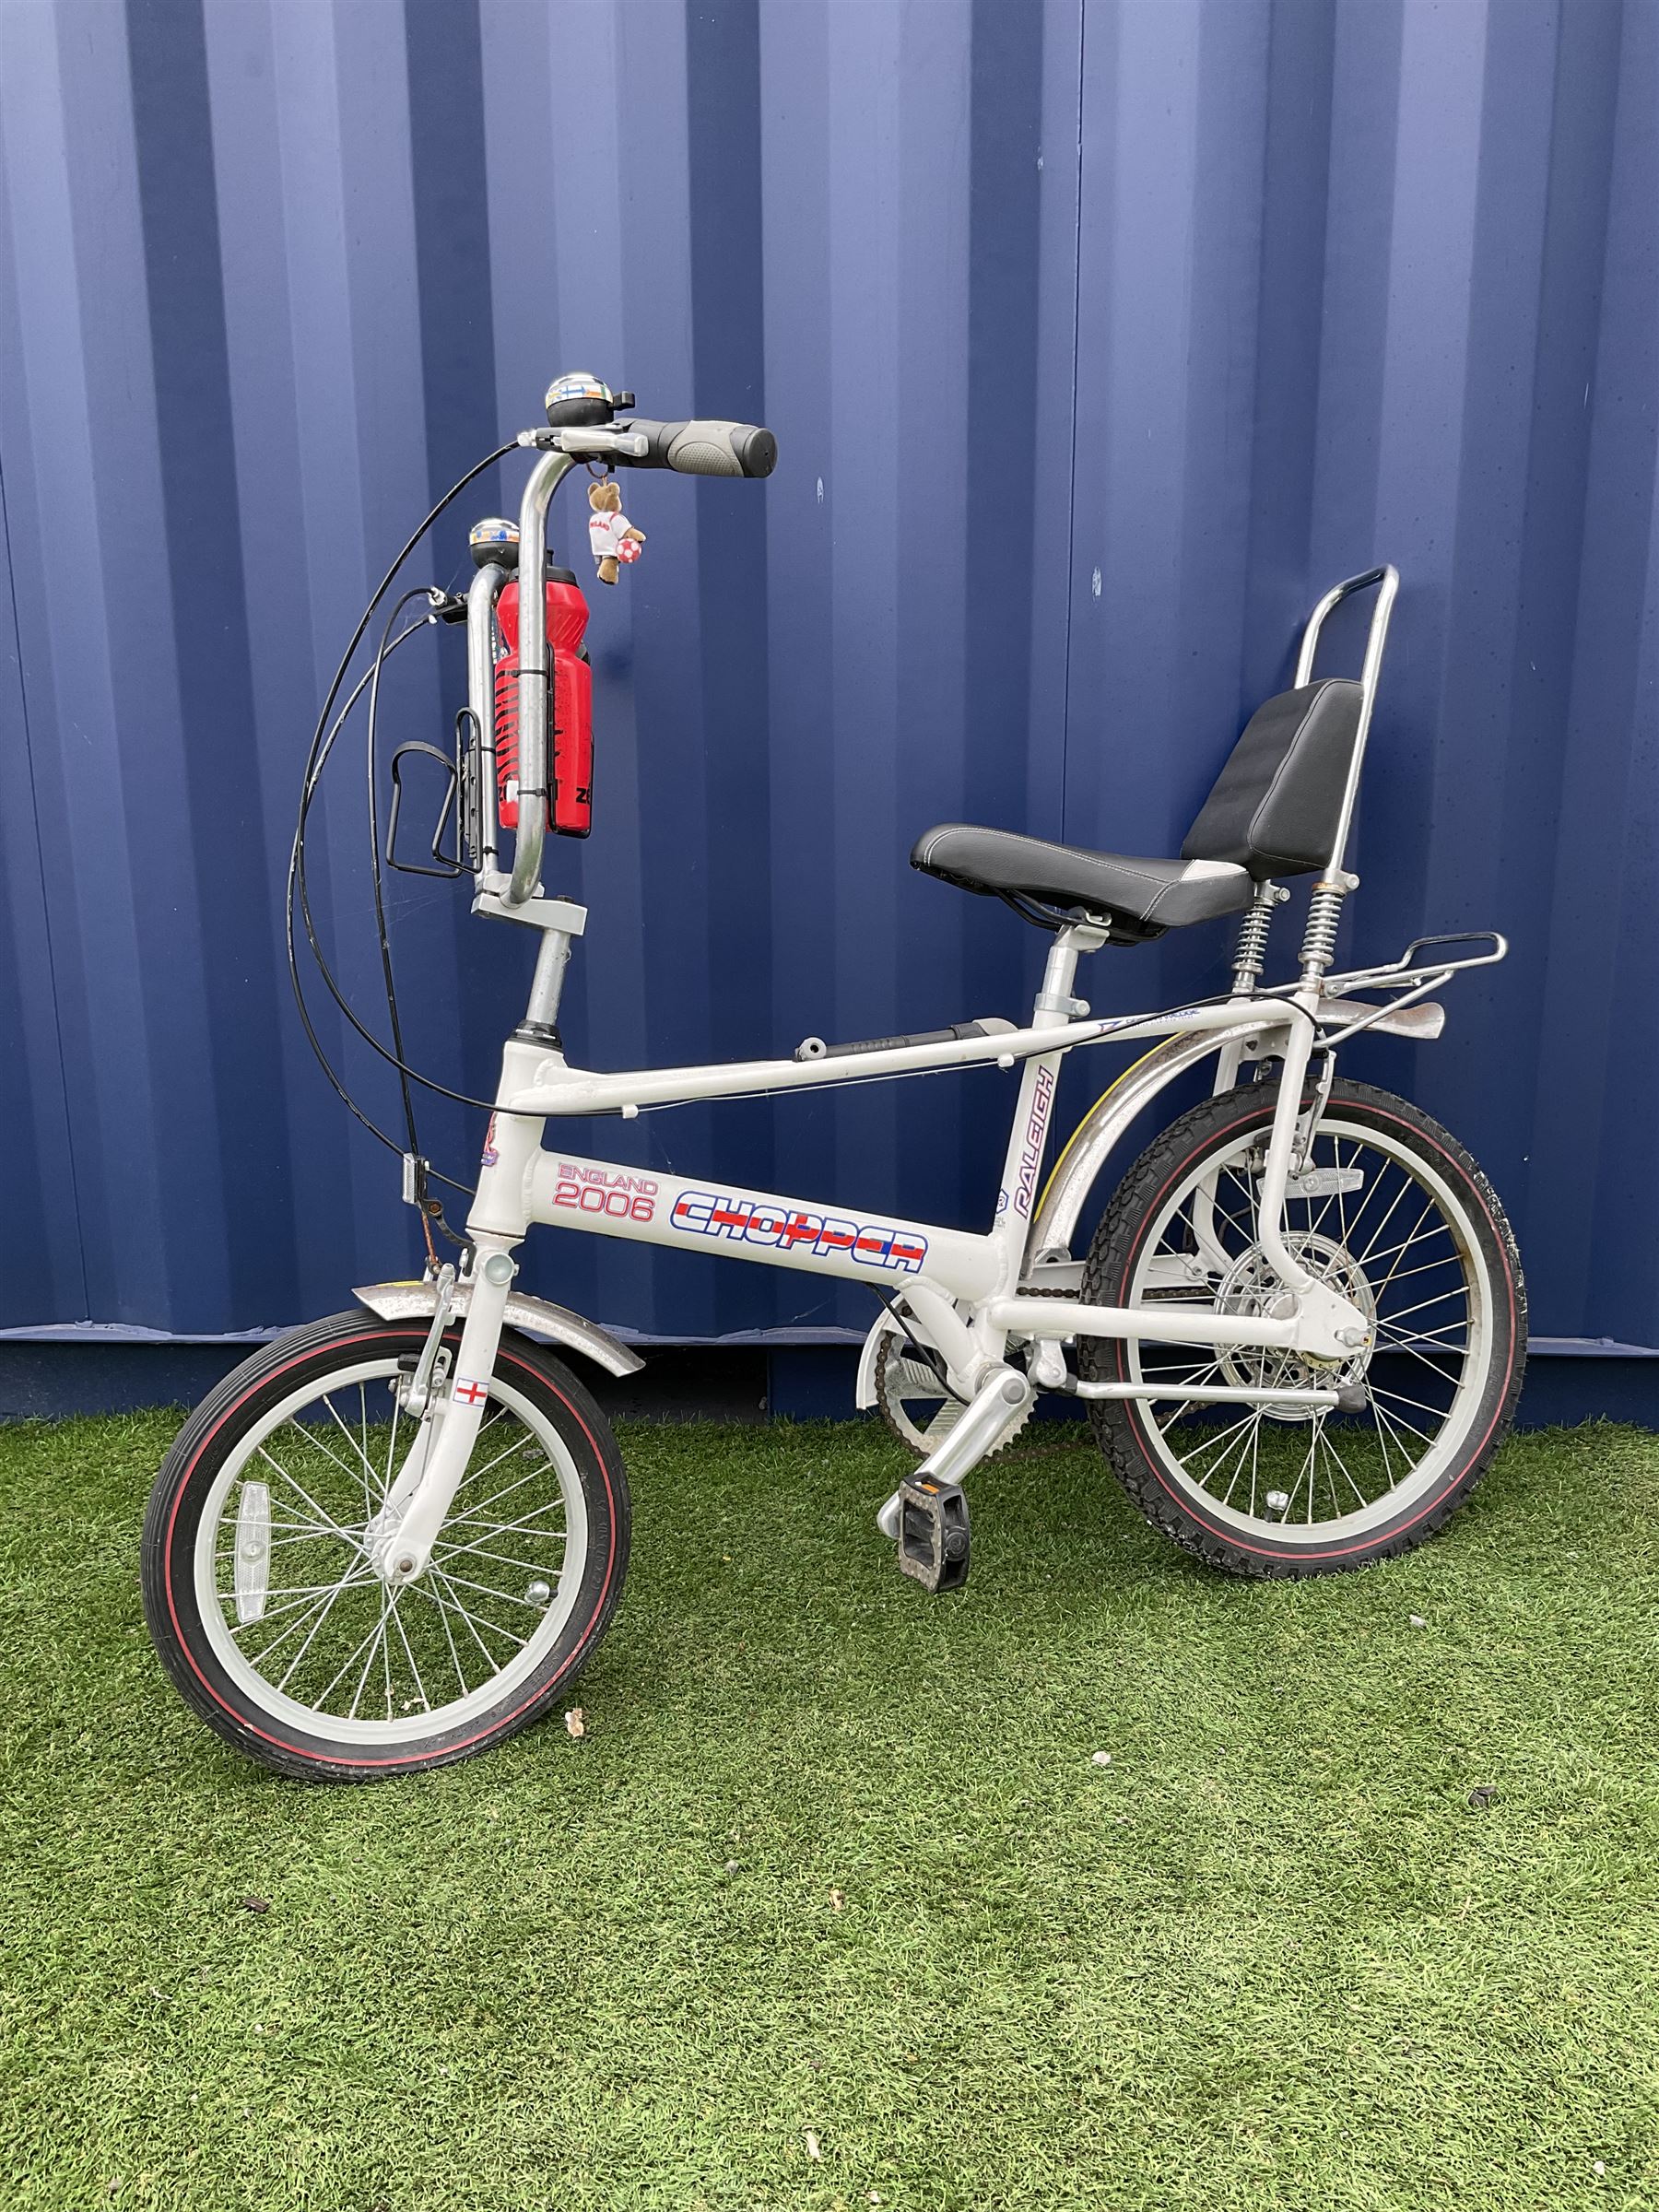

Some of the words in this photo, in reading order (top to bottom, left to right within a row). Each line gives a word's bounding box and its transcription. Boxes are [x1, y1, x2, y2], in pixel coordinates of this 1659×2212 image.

[1014, 1065, 1053, 1220] RALEIGH
[552, 1181, 656, 1222] 2006
[558, 1163, 658, 1196] ENGLAND
[670, 1190, 929, 1274] CHOPPER
